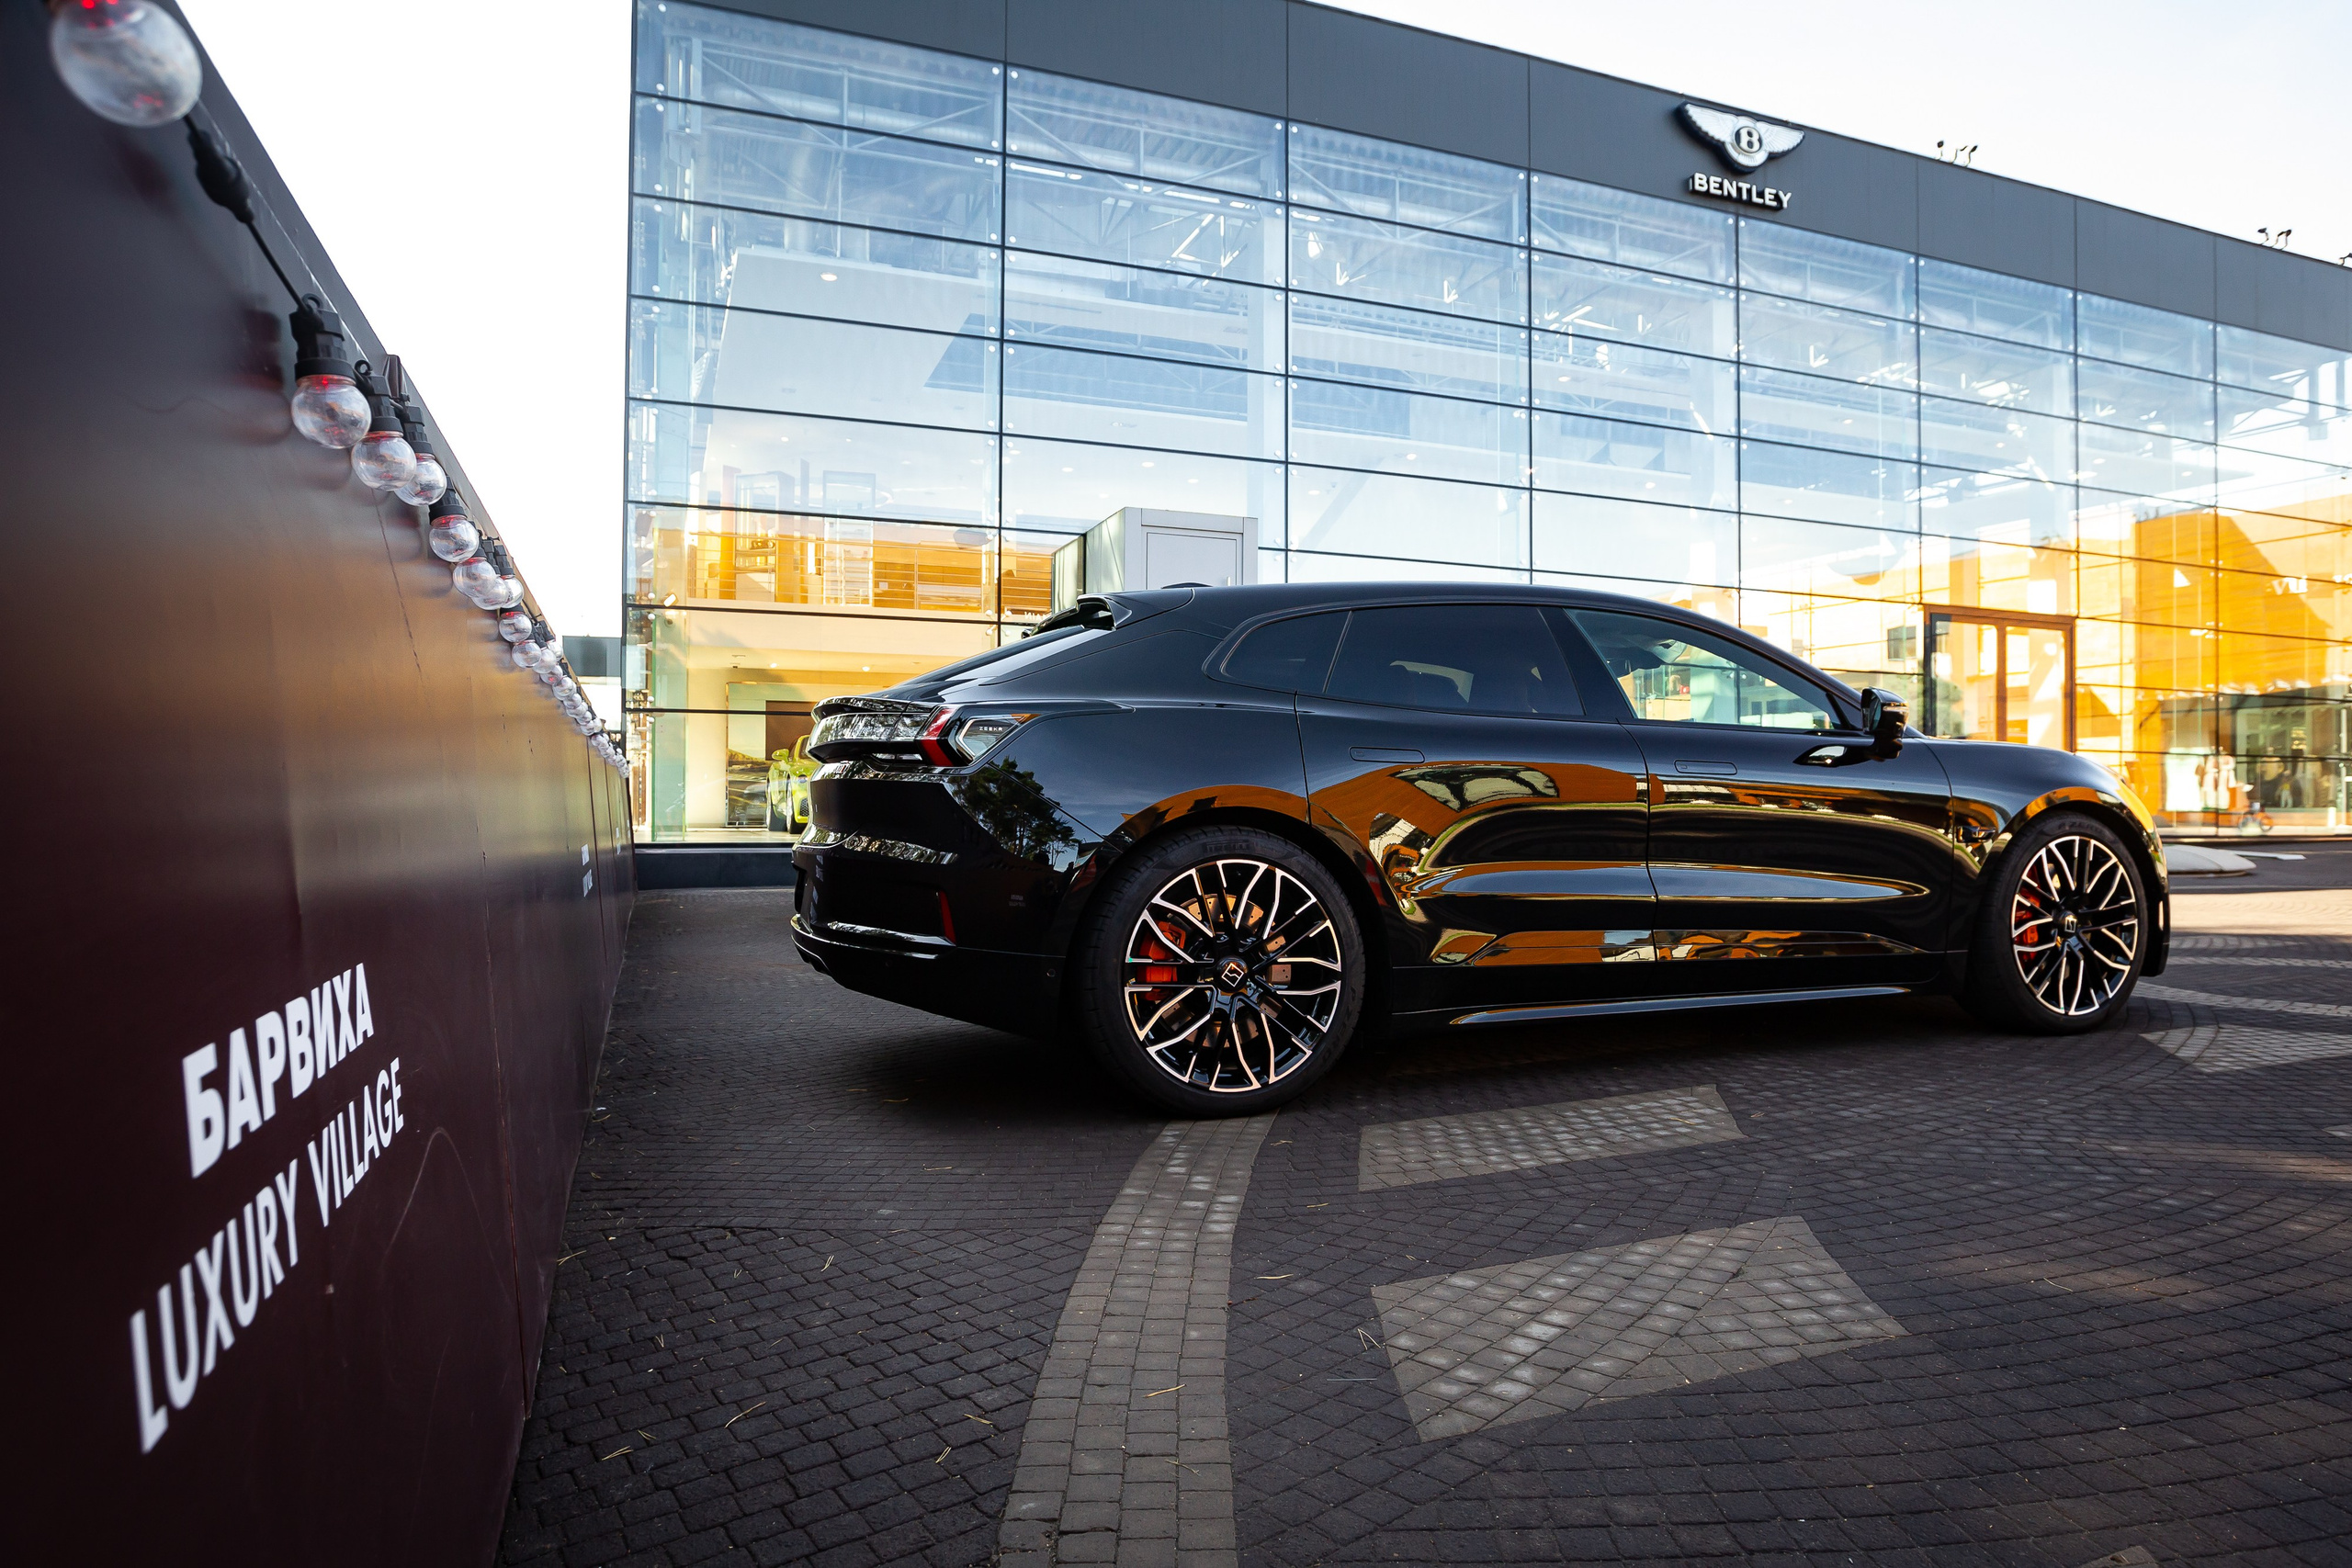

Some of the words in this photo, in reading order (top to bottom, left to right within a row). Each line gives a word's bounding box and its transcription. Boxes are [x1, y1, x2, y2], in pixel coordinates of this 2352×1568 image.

[1693, 172, 1792, 209] BENTLEY
[1738, 127, 1760, 153] B
[183, 962, 374, 1179] БАРВИХА
[130, 1157, 300, 1455] LUXURY
[307, 1057, 405, 1227] VILLAGE
